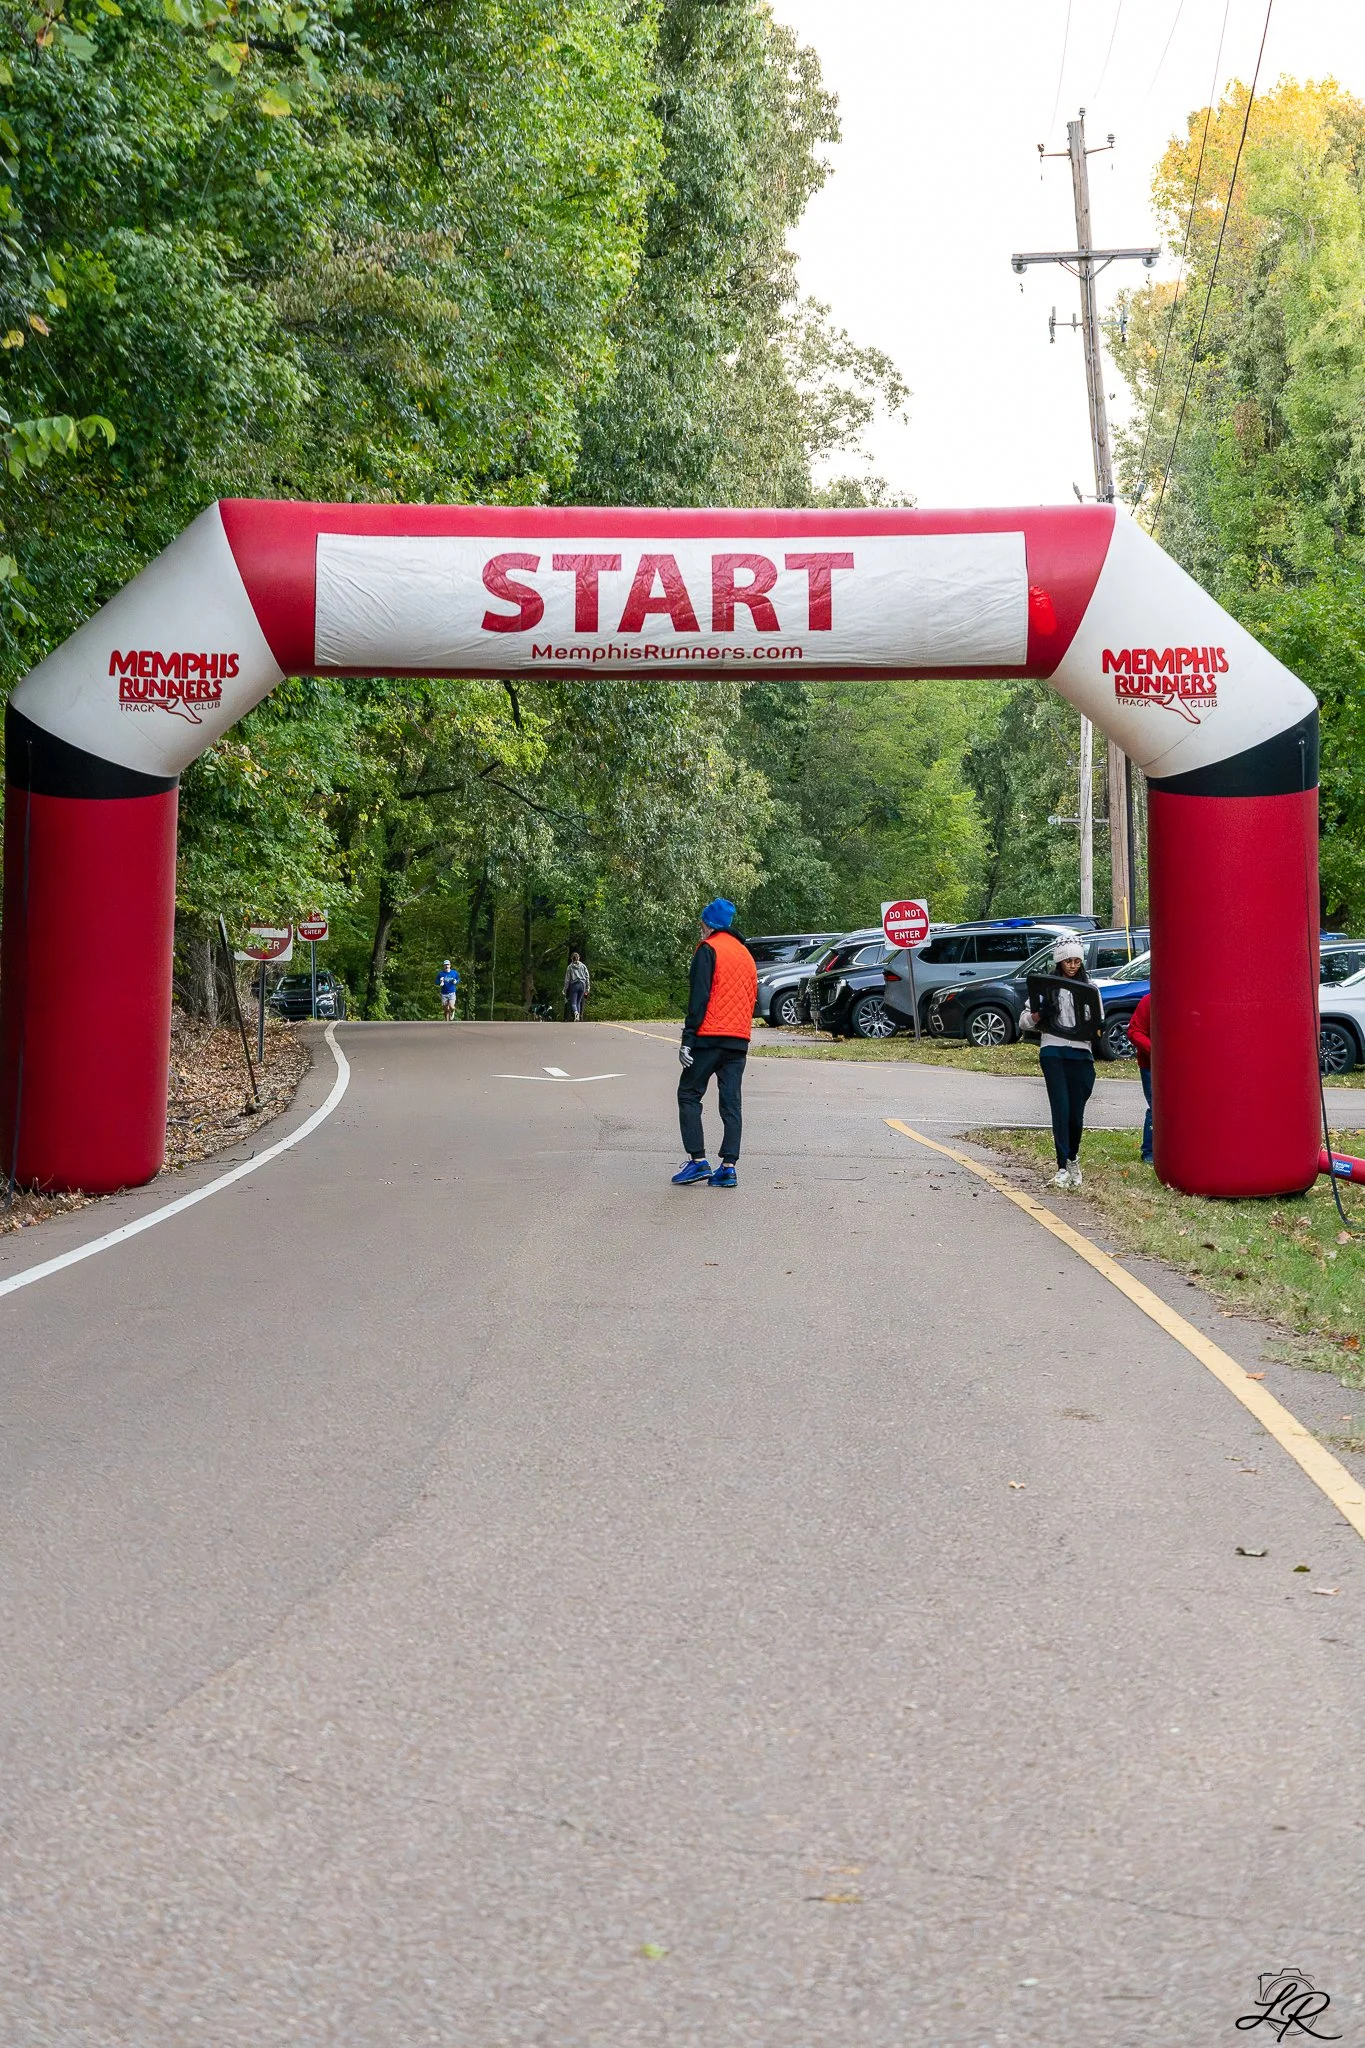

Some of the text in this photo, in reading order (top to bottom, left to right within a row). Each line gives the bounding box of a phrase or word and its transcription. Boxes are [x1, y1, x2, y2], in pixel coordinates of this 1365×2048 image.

[481, 552, 854, 633] START
[531, 643, 803, 663] MemphisRunners.com
[1102, 646, 1229, 675] MEMPHIS
[109, 650, 240, 679] MEMPHIS
[119, 677, 222, 699] RUNNERS
[1114, 673, 1217, 695] RUNNERS
[119, 701, 221, 713] TRACK CLUB
[1116, 697, 1218, 708] TRACK CLUB
[889, 908, 921, 919] DO NOT
[894, 930, 921, 940] ENTER
